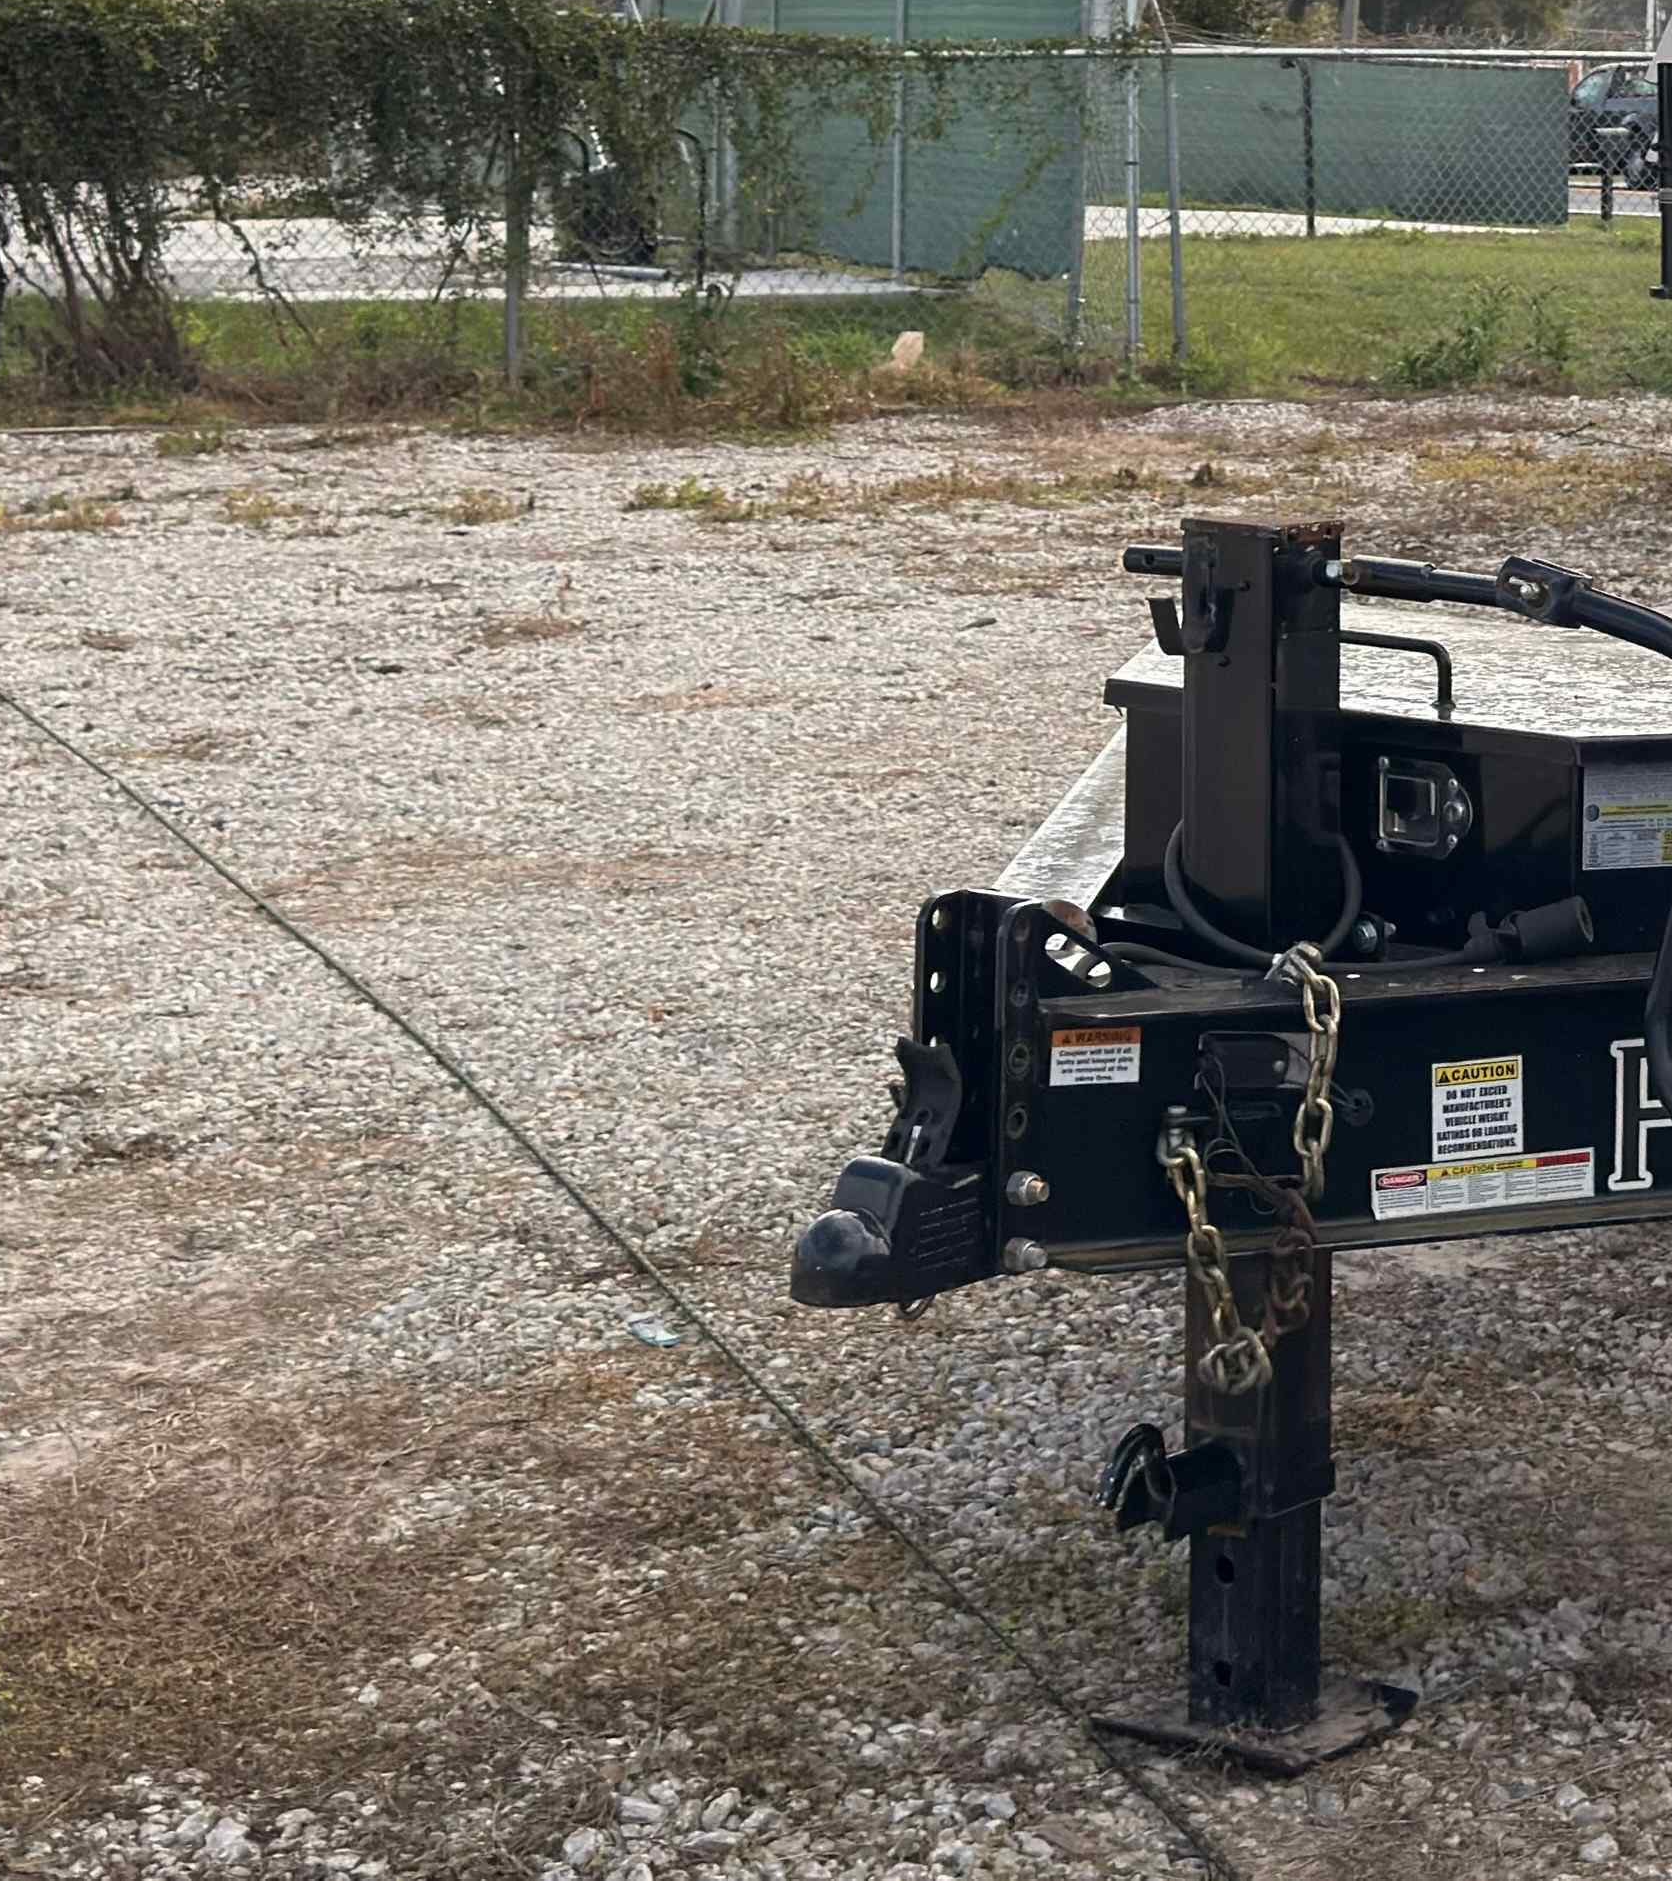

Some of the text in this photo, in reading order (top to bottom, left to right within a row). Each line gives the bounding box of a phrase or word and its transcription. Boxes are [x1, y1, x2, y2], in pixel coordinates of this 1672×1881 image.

[1452, 1064, 1515, 1081] CAUTION
[1446, 1090, 1457, 1101] DO
[1460, 1088, 1476, 1098] NOT
[1452, 1162, 1495, 1175] CAUTION
